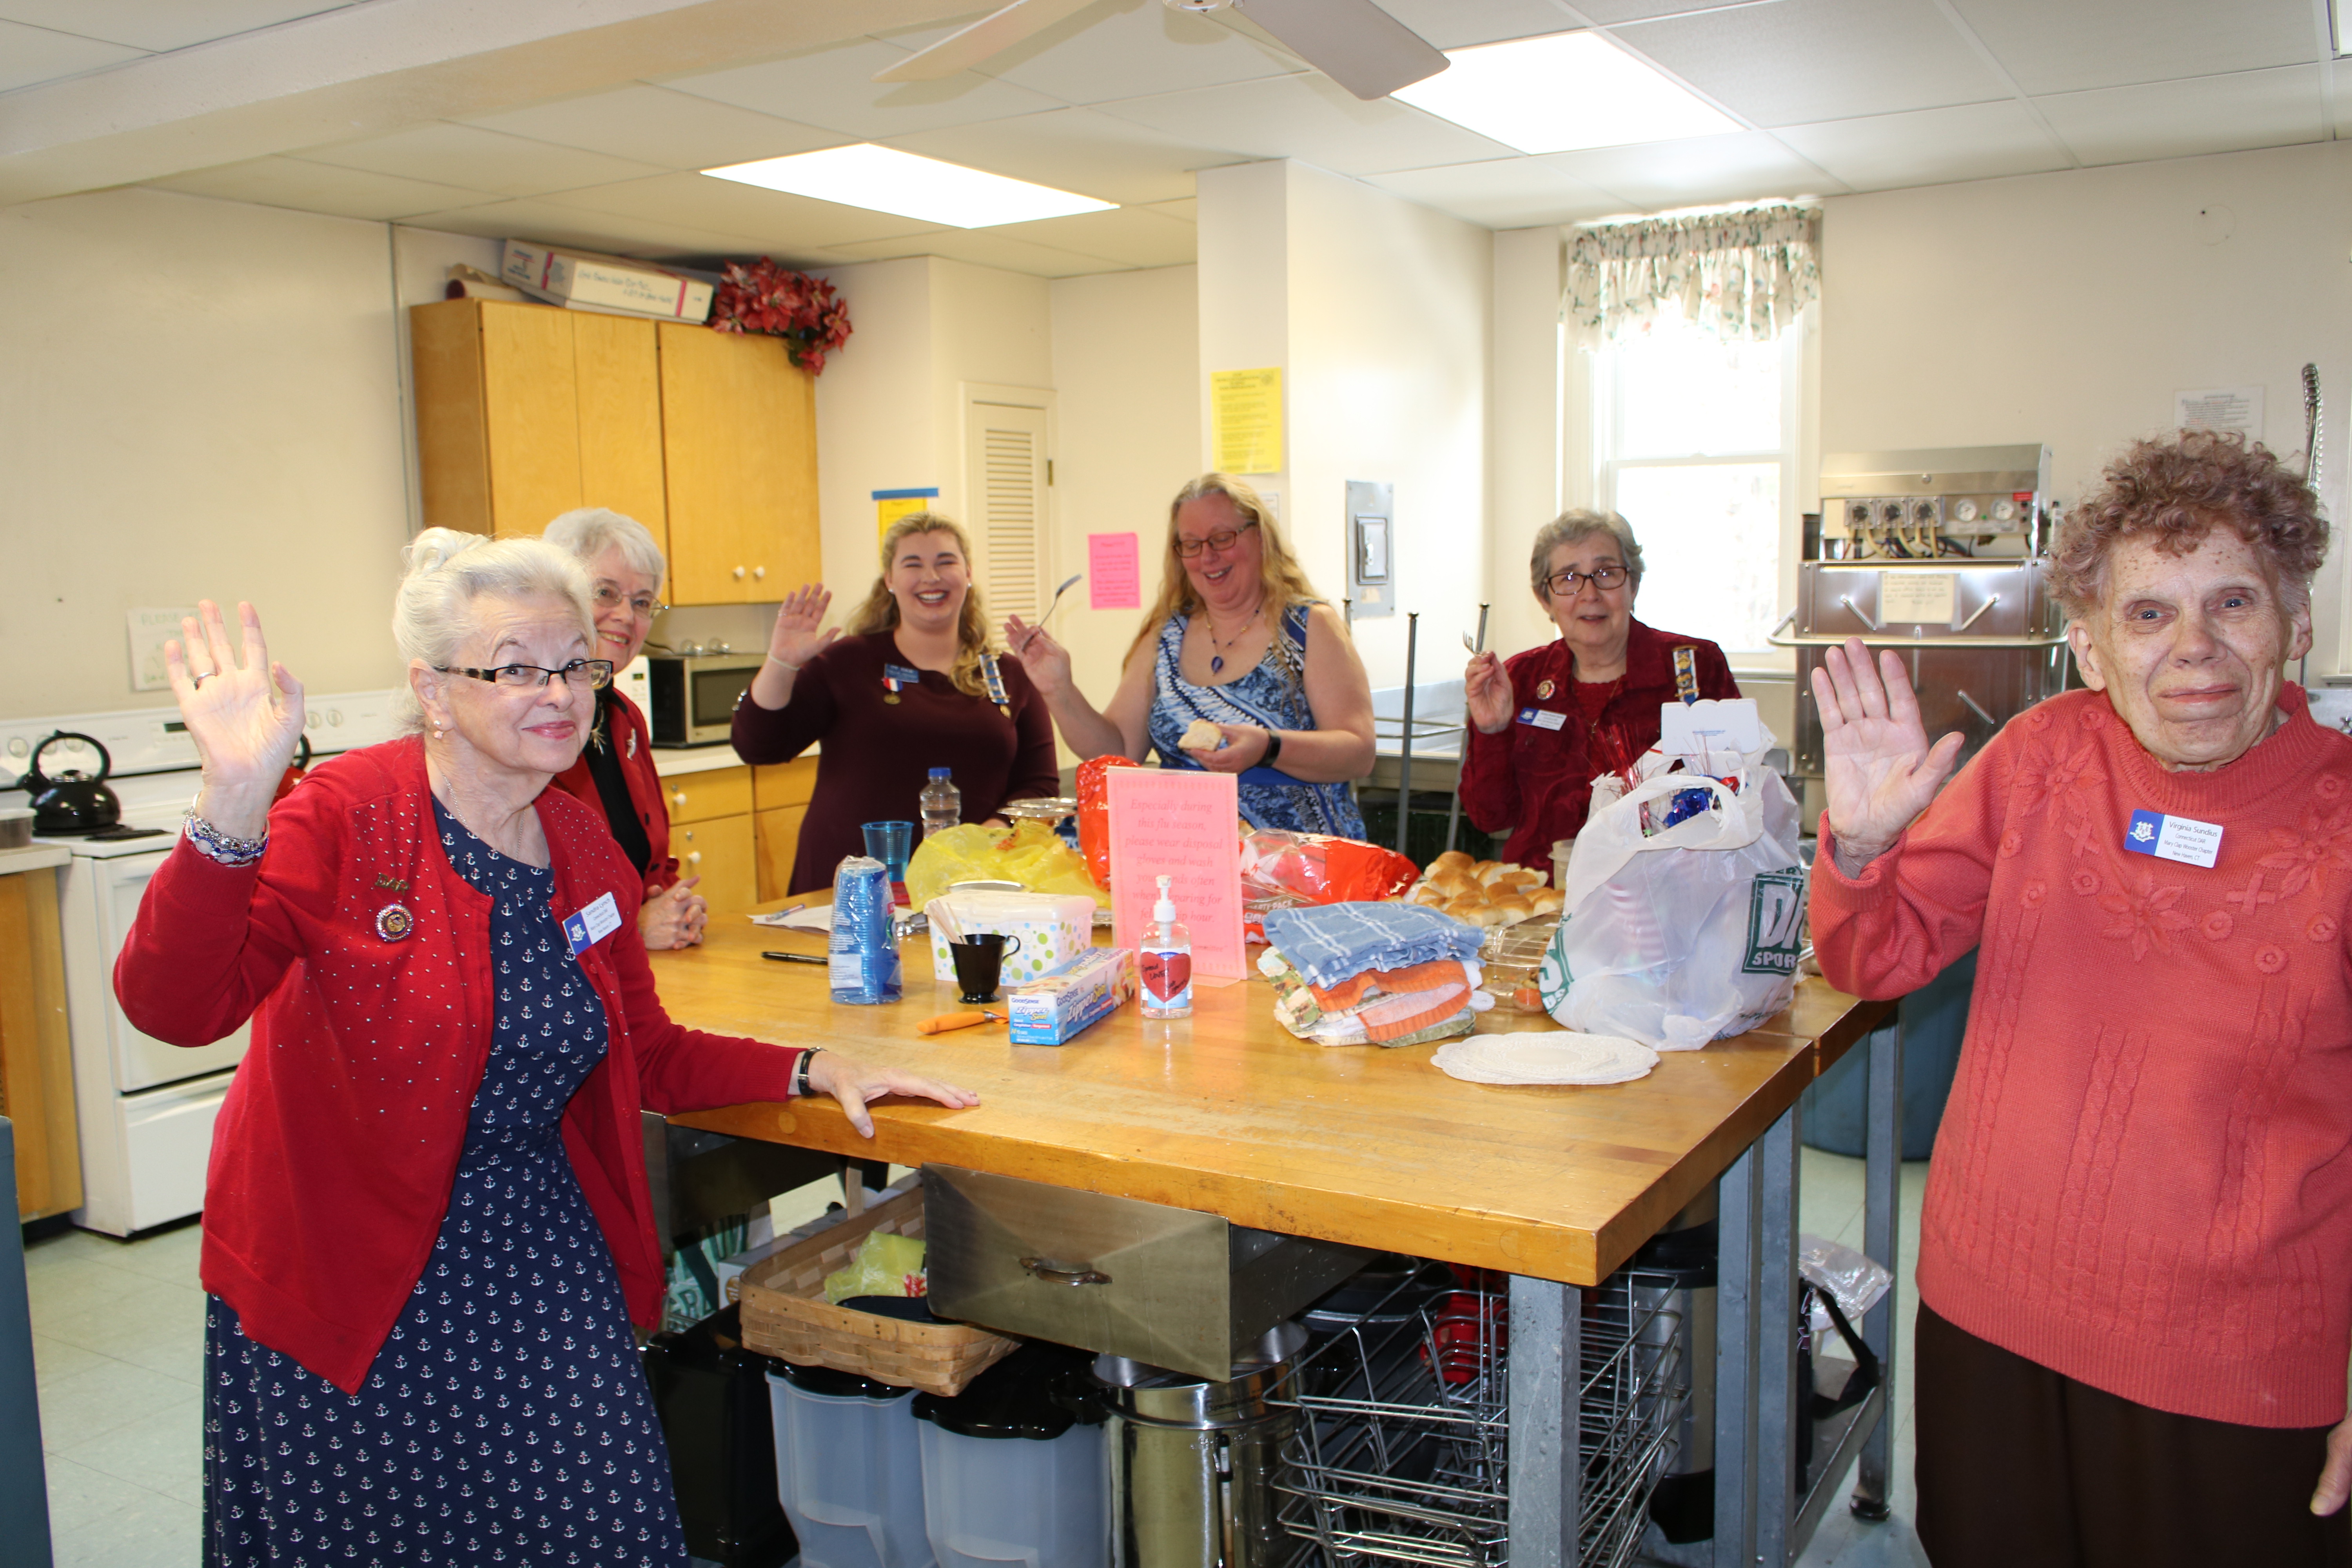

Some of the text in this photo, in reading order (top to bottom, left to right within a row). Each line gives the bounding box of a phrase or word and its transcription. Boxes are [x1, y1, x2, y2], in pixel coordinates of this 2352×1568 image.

[1131, 799, 1212, 814] Especially during
[1138, 817, 1207, 831] this flu season,
[2169, 822, 2218, 837] Virginia Sundius
[1125, 835, 1223, 851] please wear disposal
[2175, 833, 2197, 842] Connecticut
[1136, 854, 1213, 867] gloves and wash
[374, 872, 410, 895] DAR
[1136, 874, 1156, 884] you
[1191, 877, 1215, 887] often
[1132, 889, 1156, 901] when
[1207, 895, 1223, 906] for
[1273, 899, 1293, 909] PACK
[1191, 911, 1214, 923] hour.
[1752, 951, 1797, 969] SPOR
[1067, 992, 1094, 1024] Zipper
[1092, 971, 1108, 1003] Seal
[1016, 1007, 1048, 1016] Zipper
[1030, 1010, 1050, 1022] Seal
